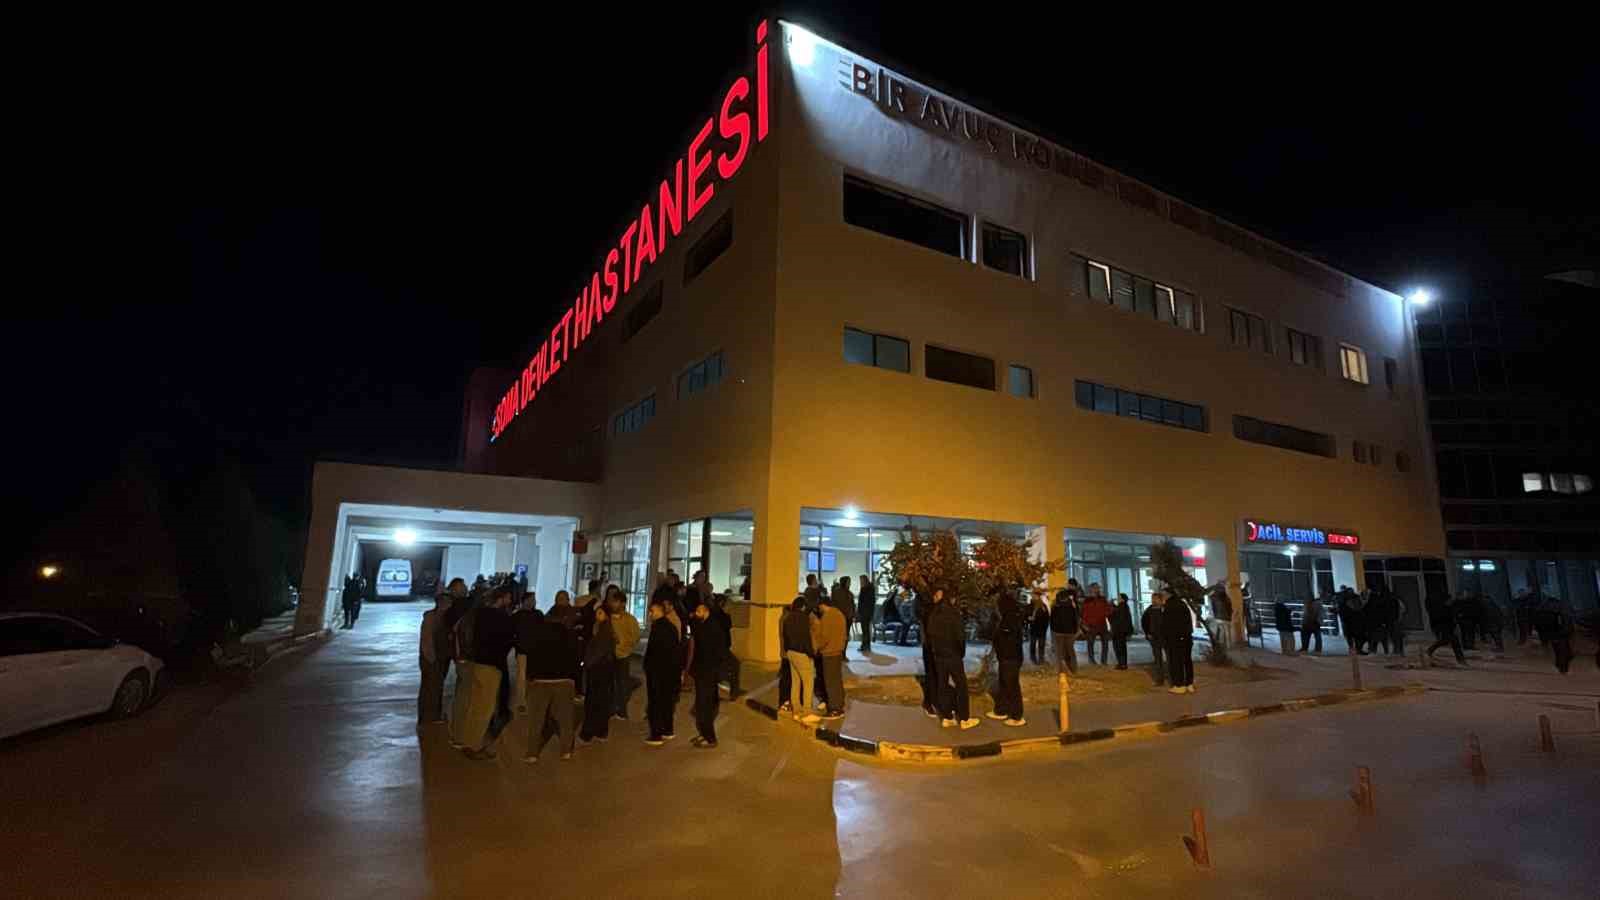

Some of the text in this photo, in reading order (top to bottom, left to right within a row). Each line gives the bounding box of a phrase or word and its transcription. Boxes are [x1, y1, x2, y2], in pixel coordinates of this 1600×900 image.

[491, 20, 769, 440] SOMA DEVLET HASTANESİ
[1257, 523, 1284, 541] ACİL
[1286, 527, 1326, 545] SERVİS
